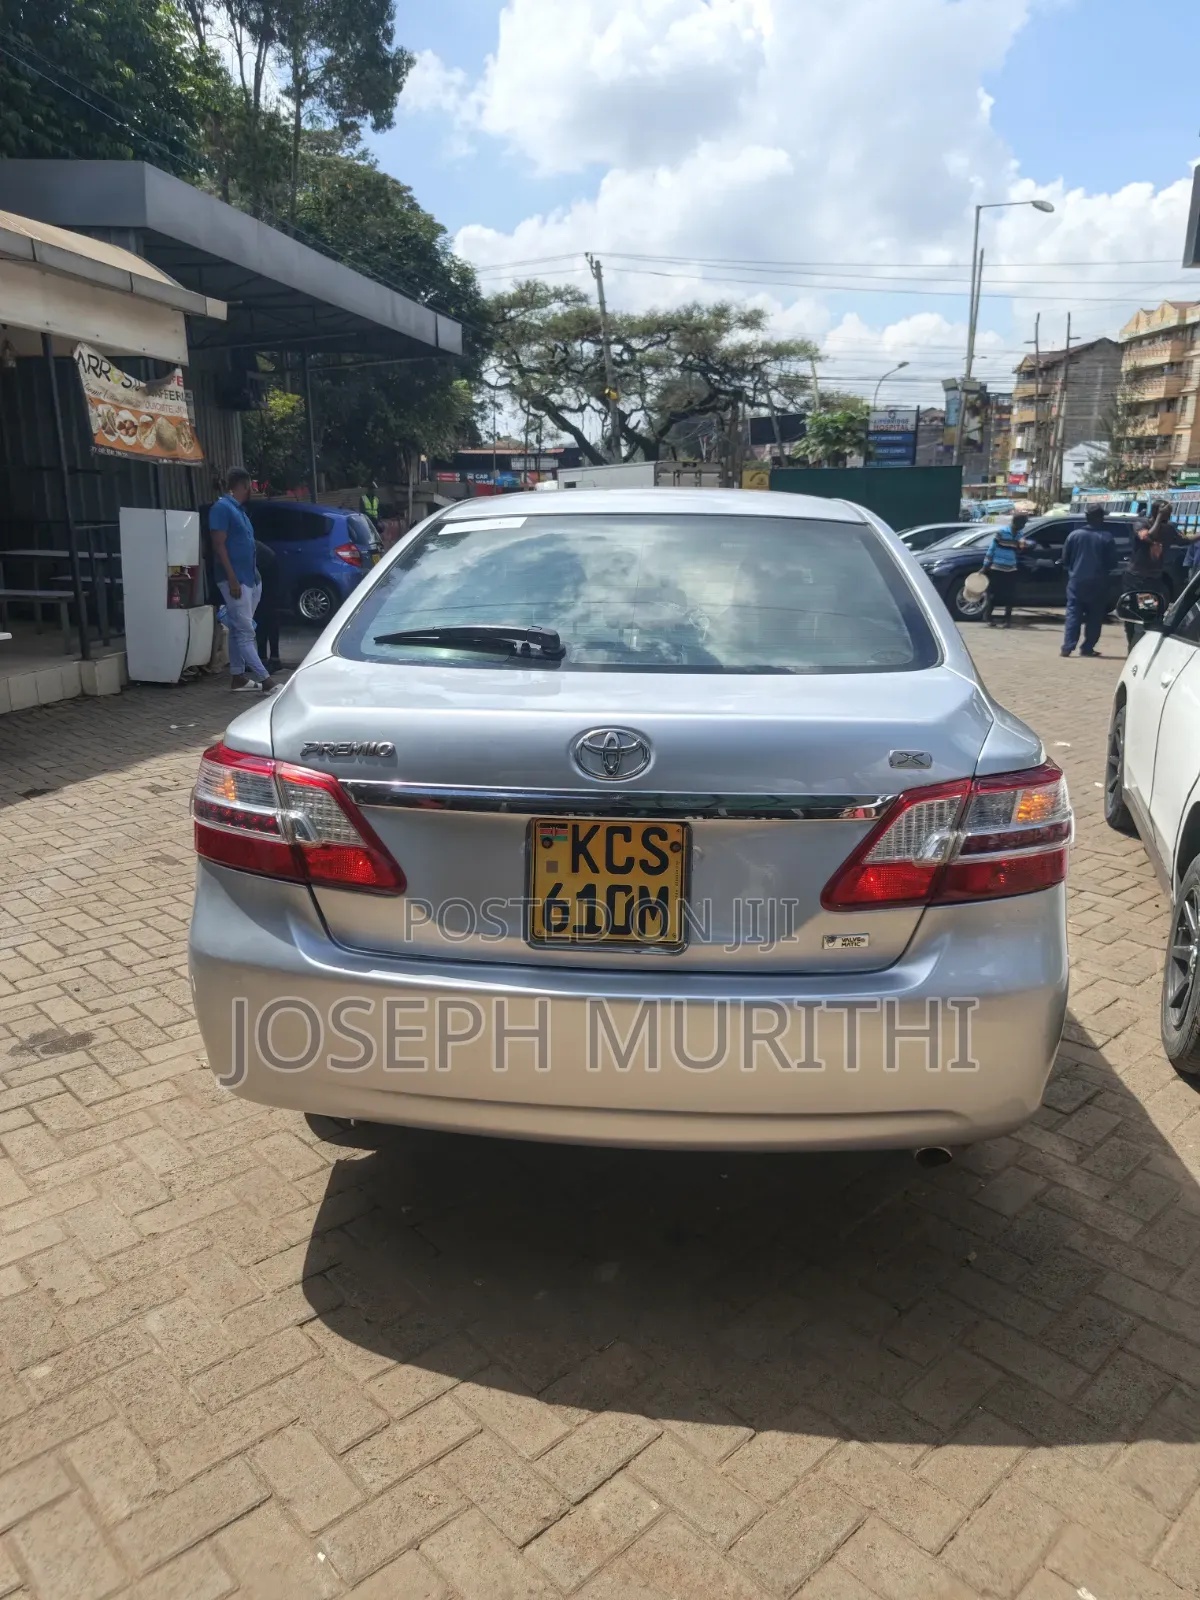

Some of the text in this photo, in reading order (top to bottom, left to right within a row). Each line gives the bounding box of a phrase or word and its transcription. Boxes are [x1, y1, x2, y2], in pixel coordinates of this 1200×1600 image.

[300, 741, 396, 758] PREMIO
[571, 824, 669, 876] KCS
[542, 883, 669, 937] 610M
